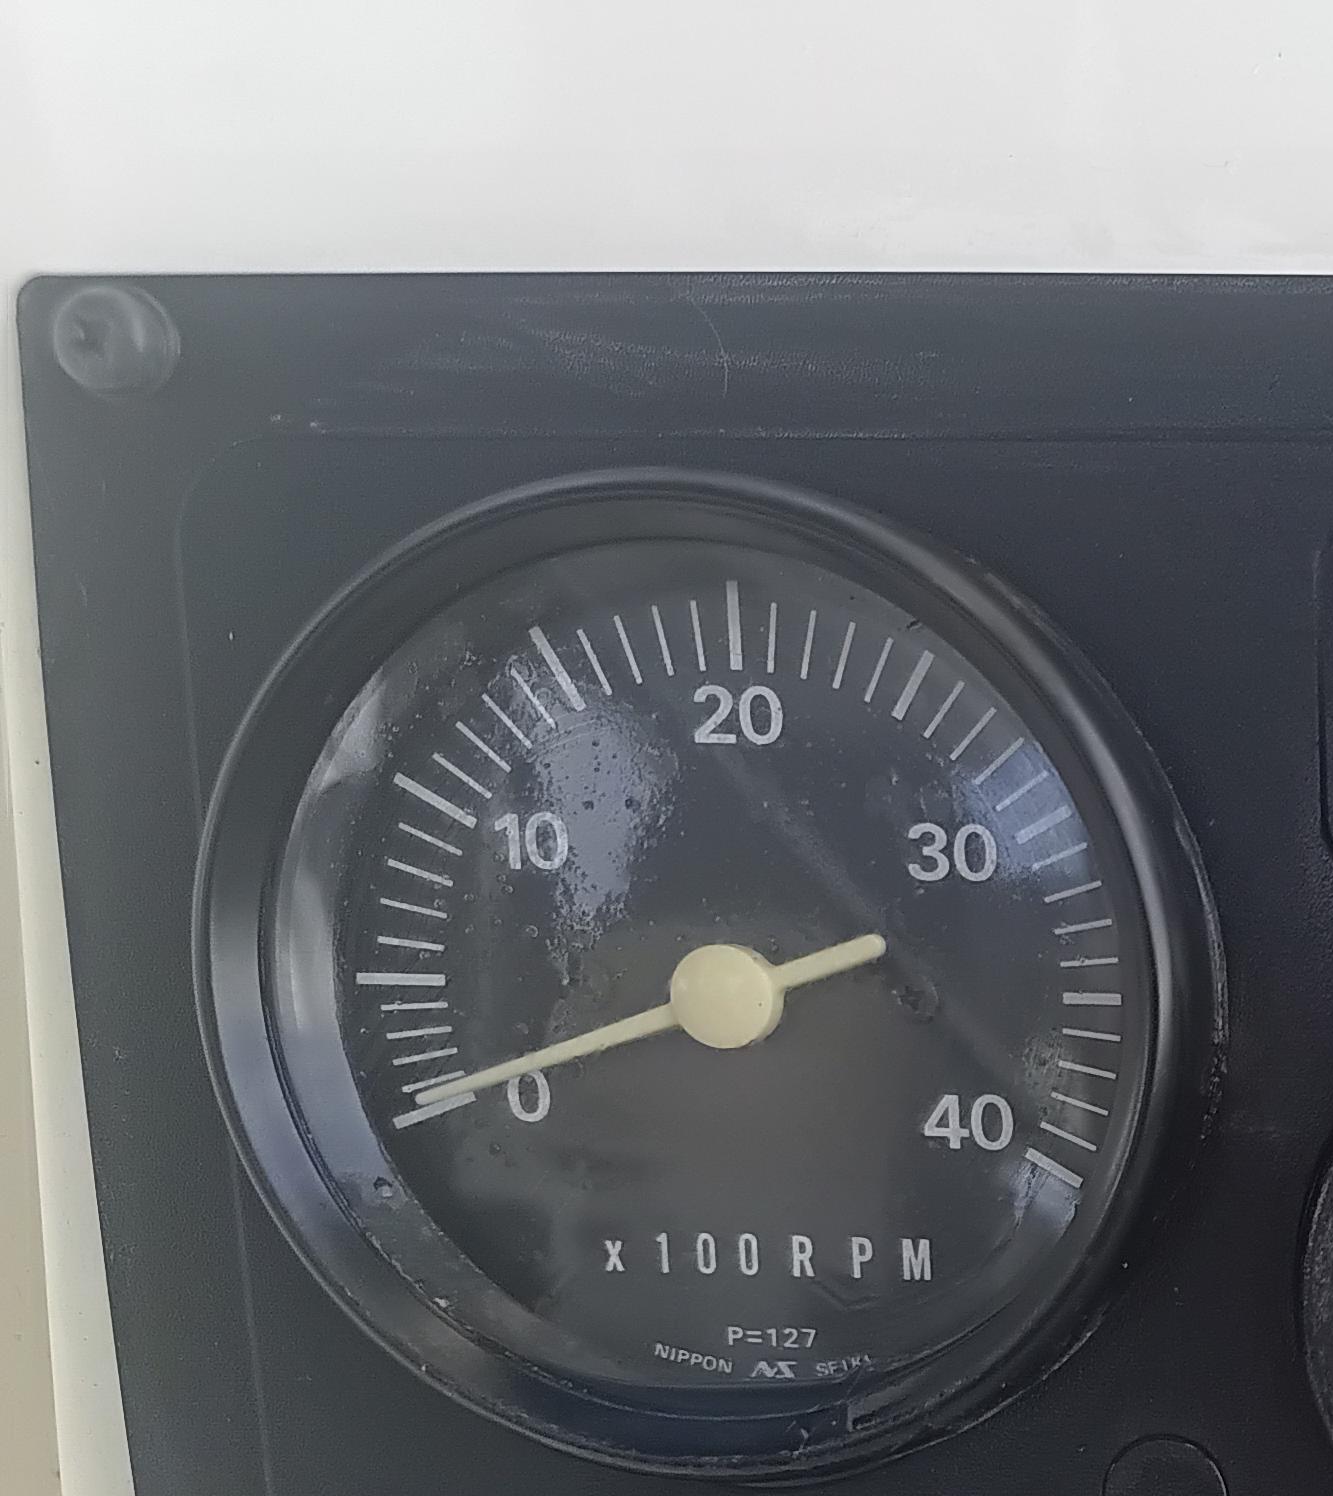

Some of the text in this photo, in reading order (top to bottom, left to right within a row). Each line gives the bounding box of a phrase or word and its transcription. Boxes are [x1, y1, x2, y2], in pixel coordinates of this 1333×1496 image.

[692, 684, 784, 745] 20
[493, 812, 570, 870] 10
[906, 822, 998, 882] 30
[506, 1070, 551, 1122] 0
[923, 1093, 1014, 1150] 40
[654, 1342, 734, 1375] NIPPON
[726, 1325, 818, 1349] P=127
